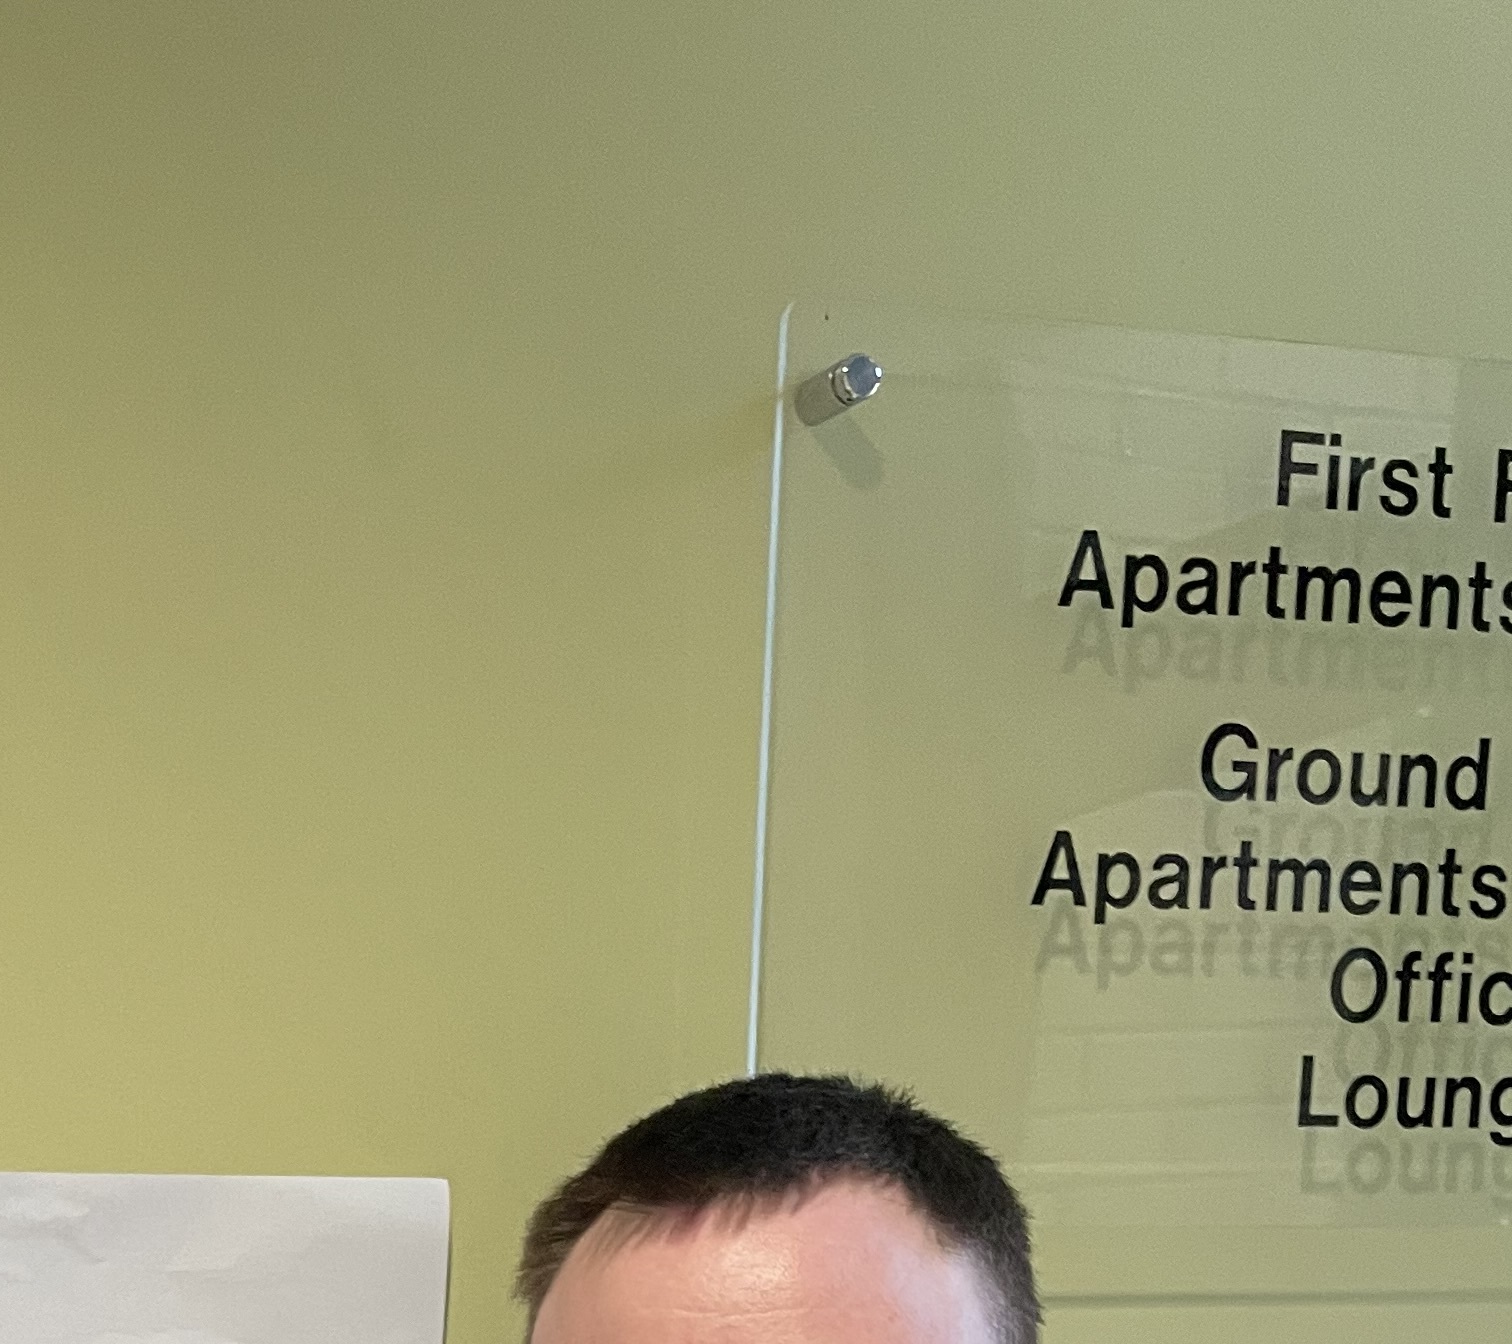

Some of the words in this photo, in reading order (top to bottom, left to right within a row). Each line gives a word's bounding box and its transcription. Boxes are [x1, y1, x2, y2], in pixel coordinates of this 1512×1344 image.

[1276, 429, 1454, 519] First
[1199, 720, 1493, 811] Ground
[1029, 829, 1508, 924] Apartments
